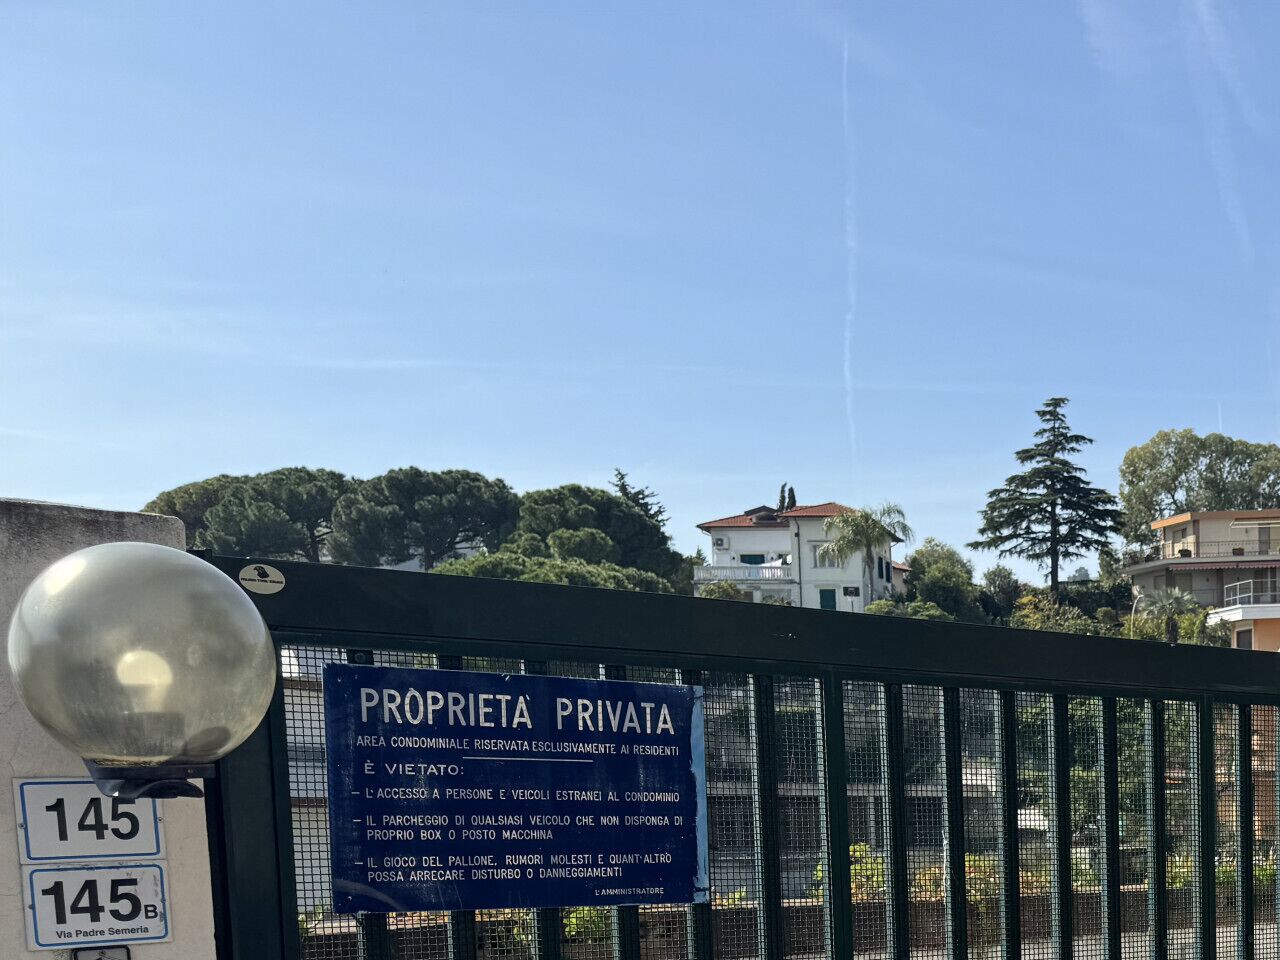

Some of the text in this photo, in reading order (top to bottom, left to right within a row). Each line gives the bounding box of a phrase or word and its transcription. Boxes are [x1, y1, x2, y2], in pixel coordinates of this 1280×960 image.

[556, 697, 675, 735] PRIVATA
[356, 735, 679, 756] AREA CONDOMINIALE RISERVATA ESCLUSIVAMENTE AI RESIDENTI
[364, 759, 464, 776] È VIETATO:
[365, 787, 680, 802] L'ACCESSO A PERSONE E VEICOLI ESTRANEI AL CONDOMINIO
[45, 797, 140, 841] 145
[366, 815, 683, 826] IL PARCHEGGIO DI QUALSIASI VEICOLO CHE NON DISPONGA DI
[367, 829, 553, 841] PROPRIO BOX O POSTO MACCHINA
[367, 857, 378, 868] IL
[383, 856, 416, 867] GIOCO
[422, 856, 443, 867] DEL
[505, 855, 544, 865] RUMORI
[550, 854, 592, 865] MOLESTI
[598, 854, 604, 864] E
[368, 867, 623, 882] POSSA ARRECARE DISTURBO O DANNEGGIAMENTI
[56, 925, 149, 939] Via Padre Semeria
